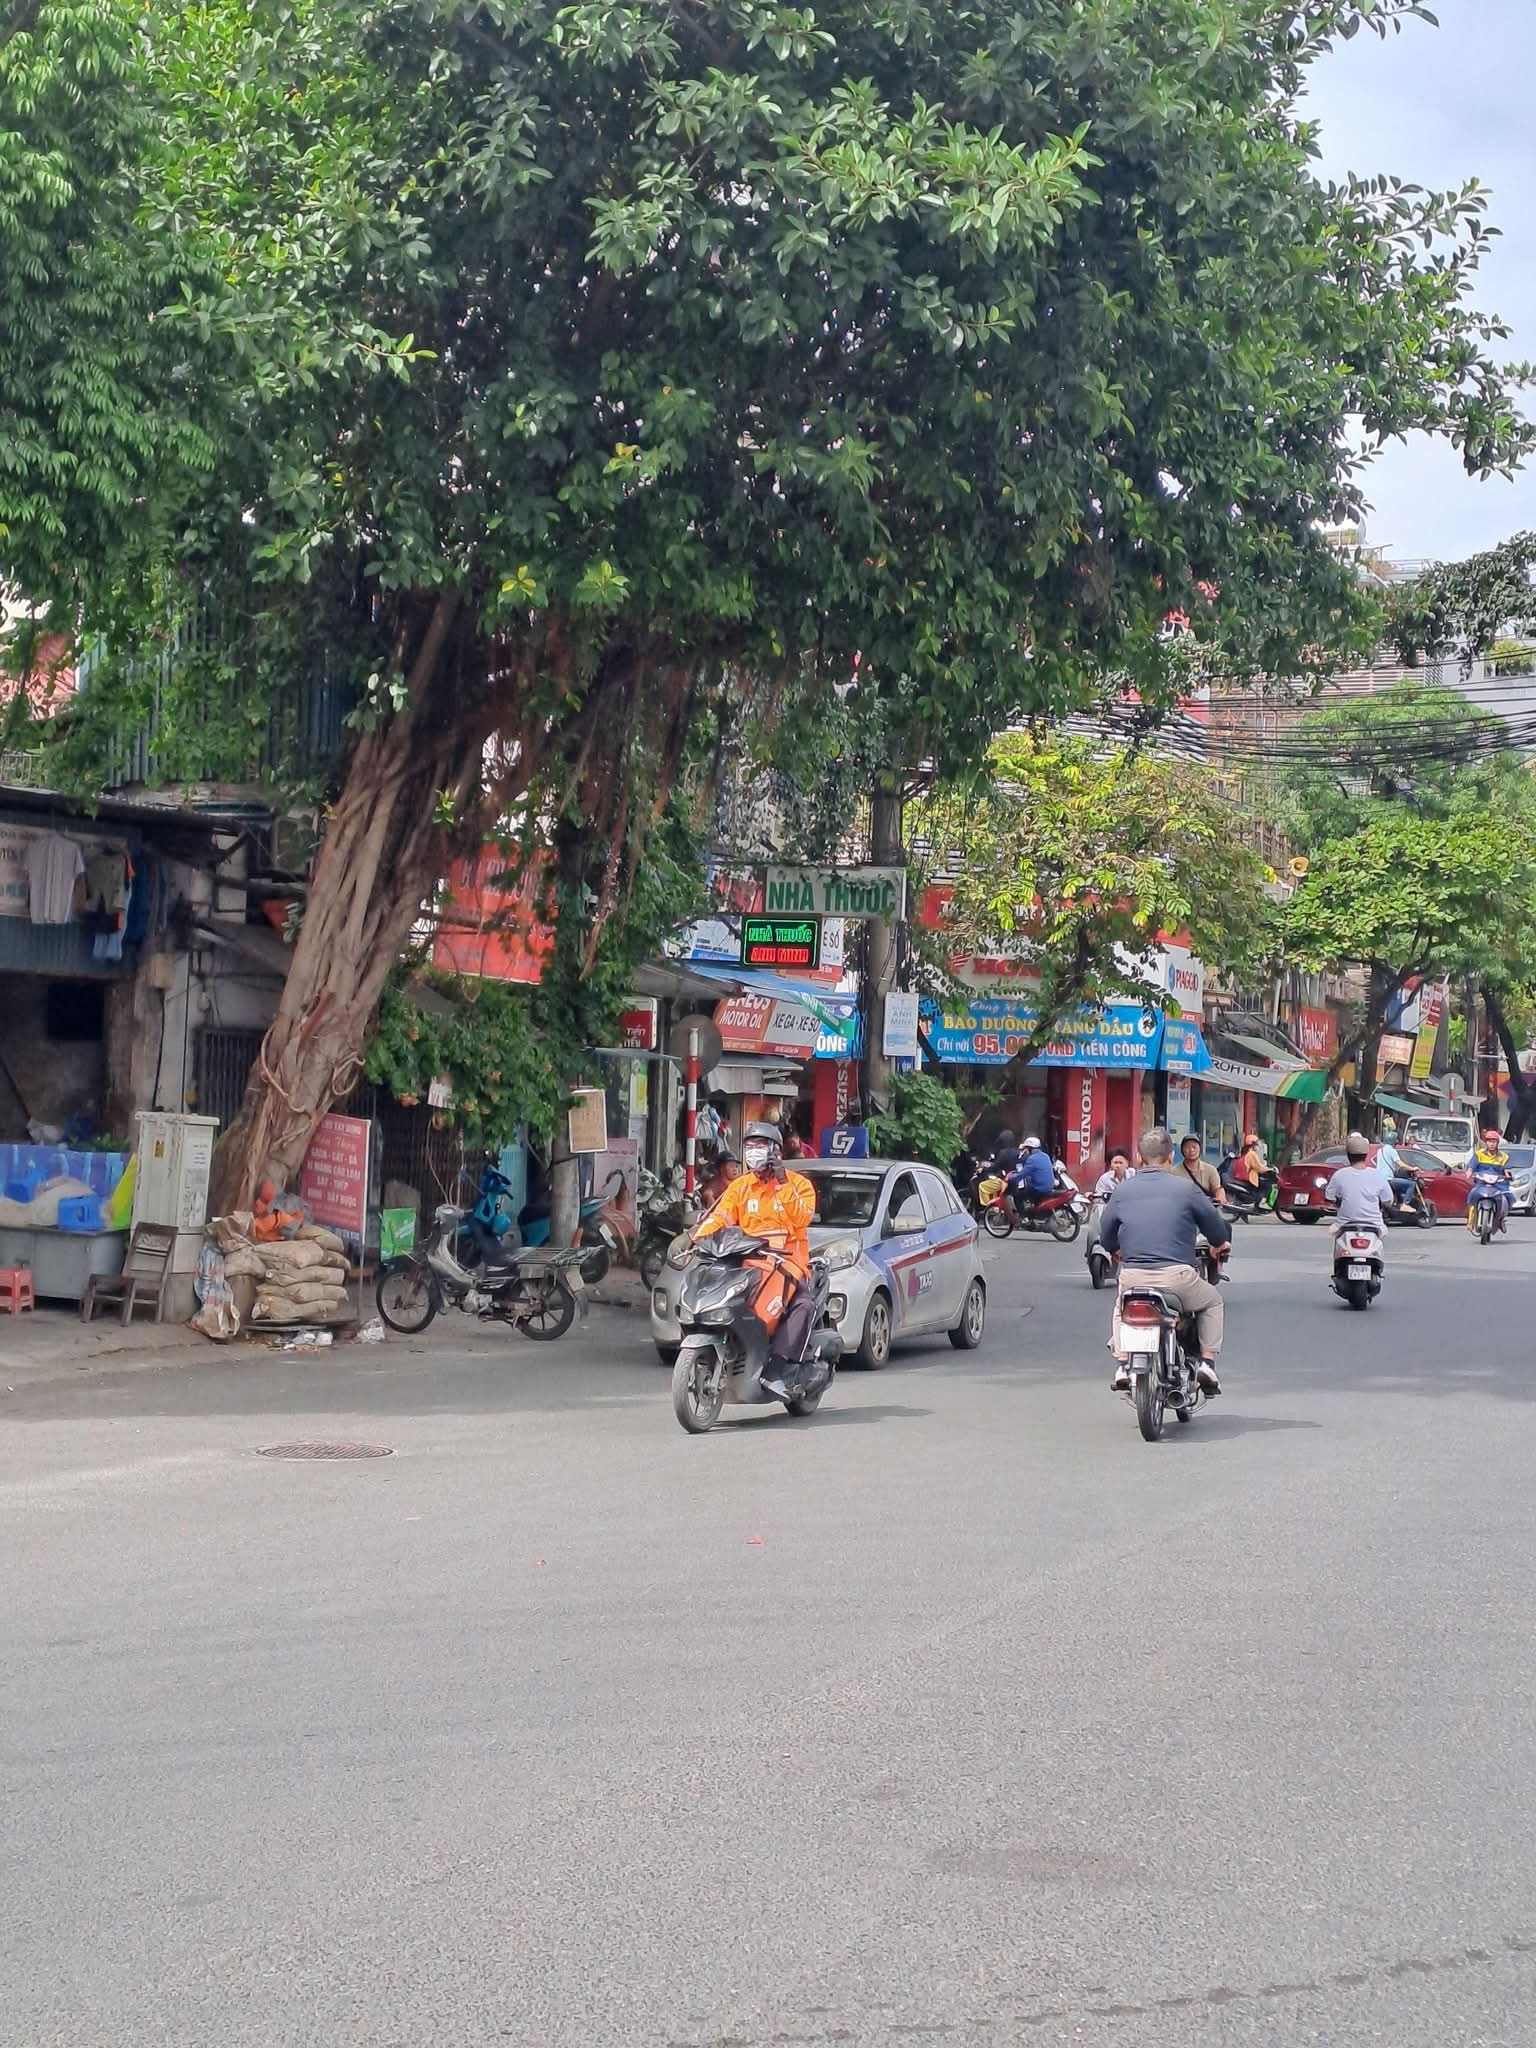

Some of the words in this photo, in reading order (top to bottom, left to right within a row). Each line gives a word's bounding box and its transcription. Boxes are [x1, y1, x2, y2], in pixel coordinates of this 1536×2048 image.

[749, 925, 773, 942] NHÀ
[775, 924, 813, 943] THUỐC
[1175, 970, 1199, 992] PIAGGIO
[719, 1010, 750, 1028] MOTOR
[749, 1013, 763, 1029] OIL
[1080, 1079, 1092, 1165] HONDA
